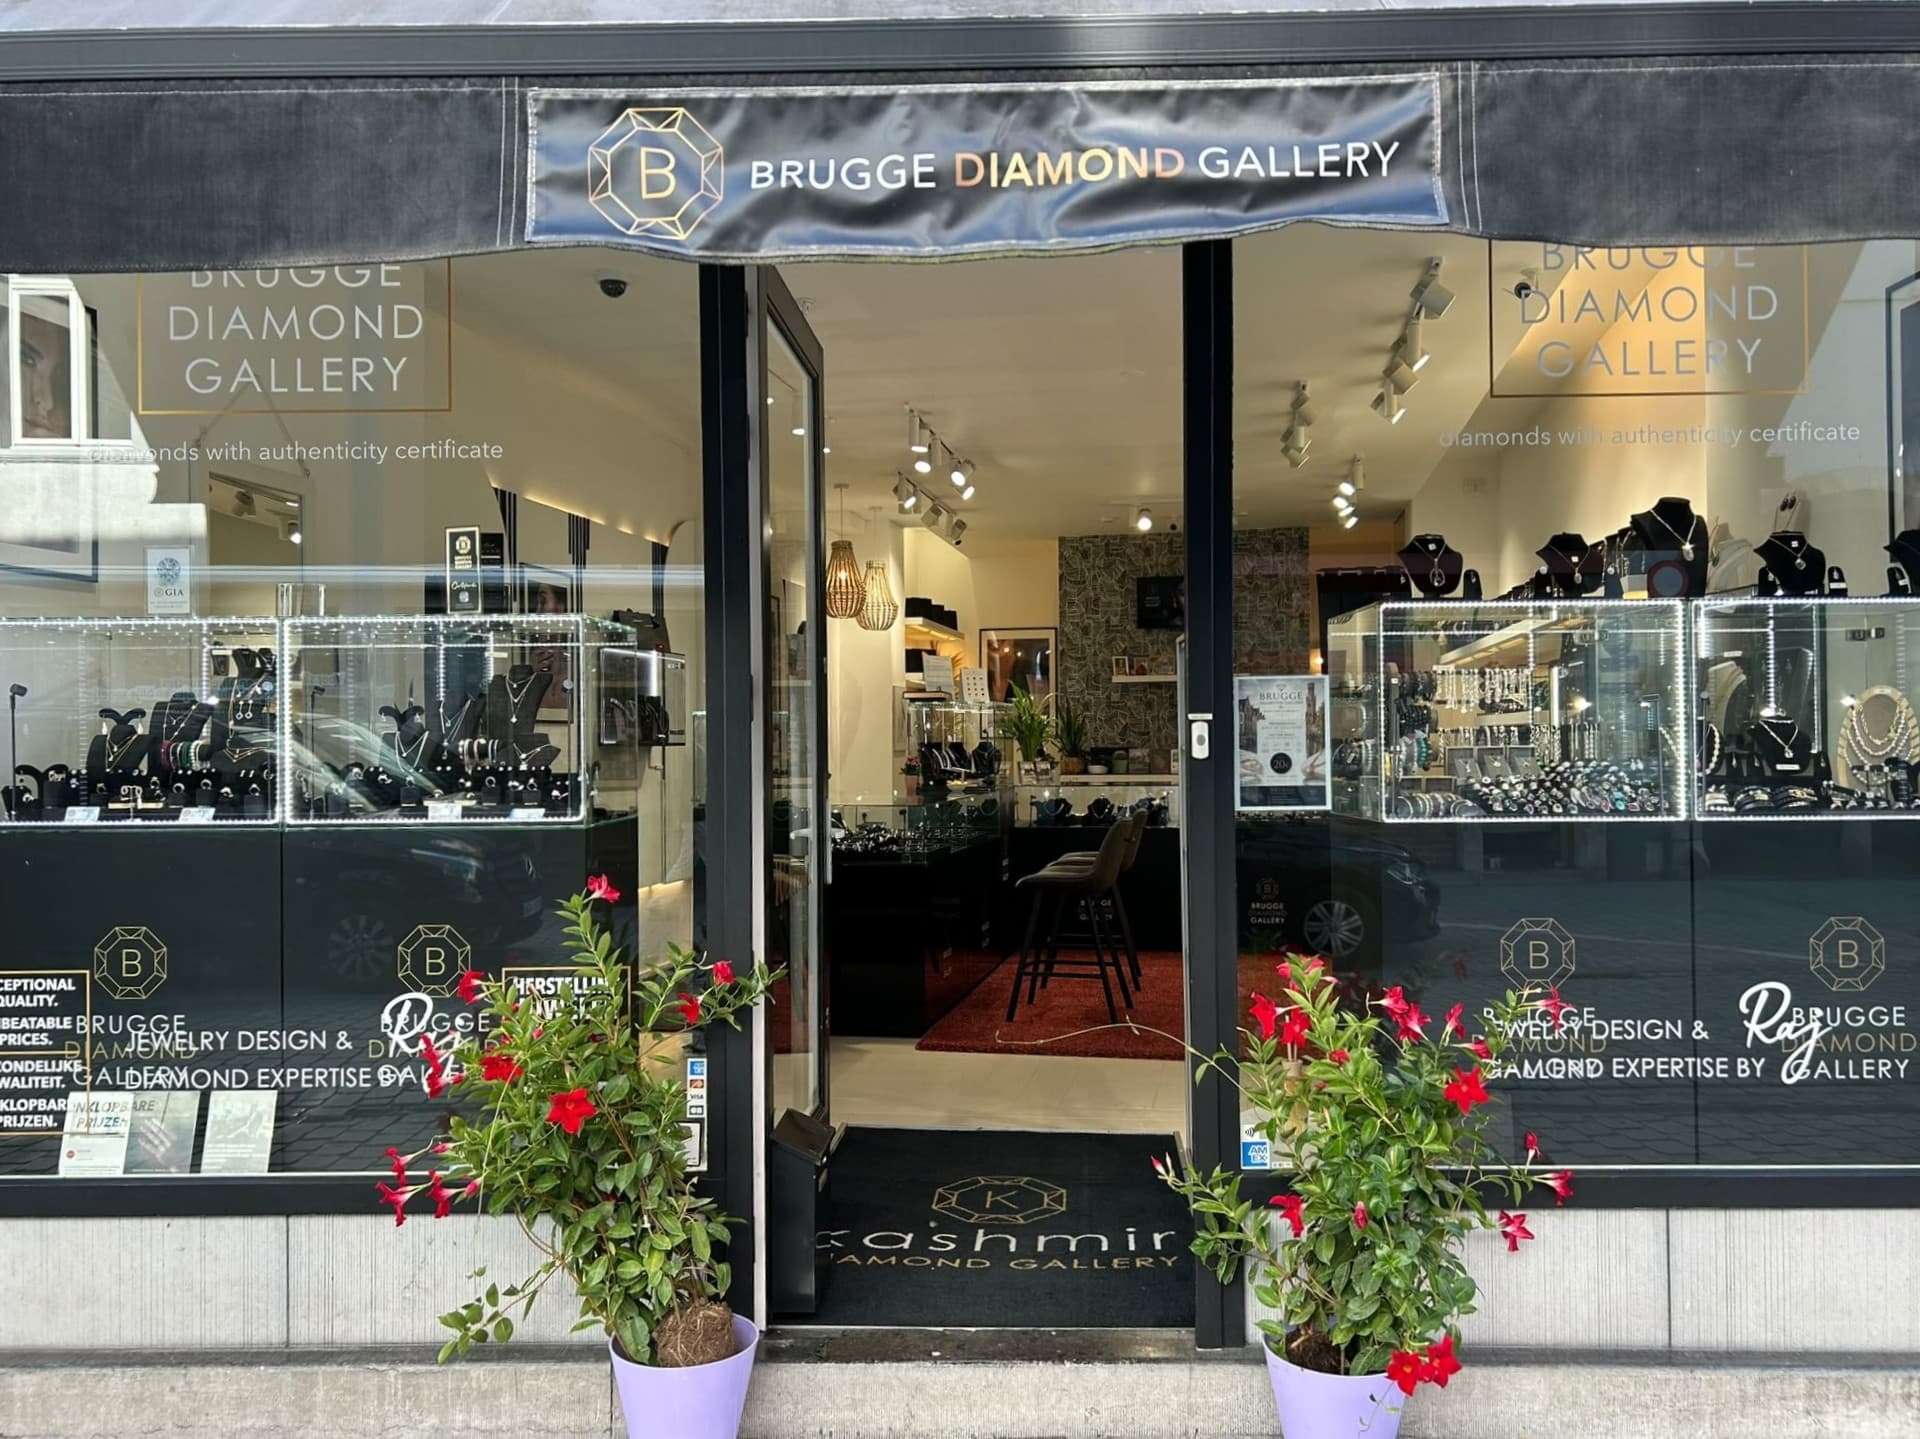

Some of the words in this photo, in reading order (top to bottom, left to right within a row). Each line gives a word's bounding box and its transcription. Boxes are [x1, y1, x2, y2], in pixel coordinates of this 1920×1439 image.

[641, 146, 676, 199] B
[750, 154, 936, 190] BRUGGE
[954, 147, 1185, 188] DIAMOND
[1198, 140, 1400, 180] GALLERY
[1520, 285, 1778, 325] DIAMOND
[168, 304, 424, 341] DIAMOND
[1537, 338, 1762, 378] GALLERY
[184, 357, 407, 394] GALLERY
[1439, 425, 1551, 447] diamonds
[1750, 420, 1861, 443] certificate
[206, 440, 251, 462] with
[258, 439, 388, 465] authenticity
[394, 438, 503, 462] certificate
[1259, 691, 1304, 701] BRUGGE
[121, 948, 142, 977] B
[426, 947, 445, 976] B
[1529, 940, 1550, 970] B
[1838, 940, 1859, 968] B
[76, 1015, 186, 1034] BRUGGE
[1793, 1006, 1906, 1027] BRUGGE
[0, 1033, 53, 1045] PRICES.
[125, 1031, 230, 1051] JEWELRY
[238, 1031, 327, 1050] DESIGN
[335, 1031, 353, 1050] &
[1592, 1020, 1682, 1039] DESIGN
[1691, 1020, 1710, 1039] &
[1781, 1033, 1917, 1053] DIAMOND
[125, 1069, 249, 1089] DIAMOND
[257, 1068, 371, 1088] EXPERTISE
[1612, 1058, 1729, 1078] EXPERTISE
[1736, 1057, 1766, 1078] BY
[1790, 1059, 1909, 1079] GALLERY
[984, 1191, 1020, 1209] K
[1009, 1256, 1180, 1270] GALLERY
